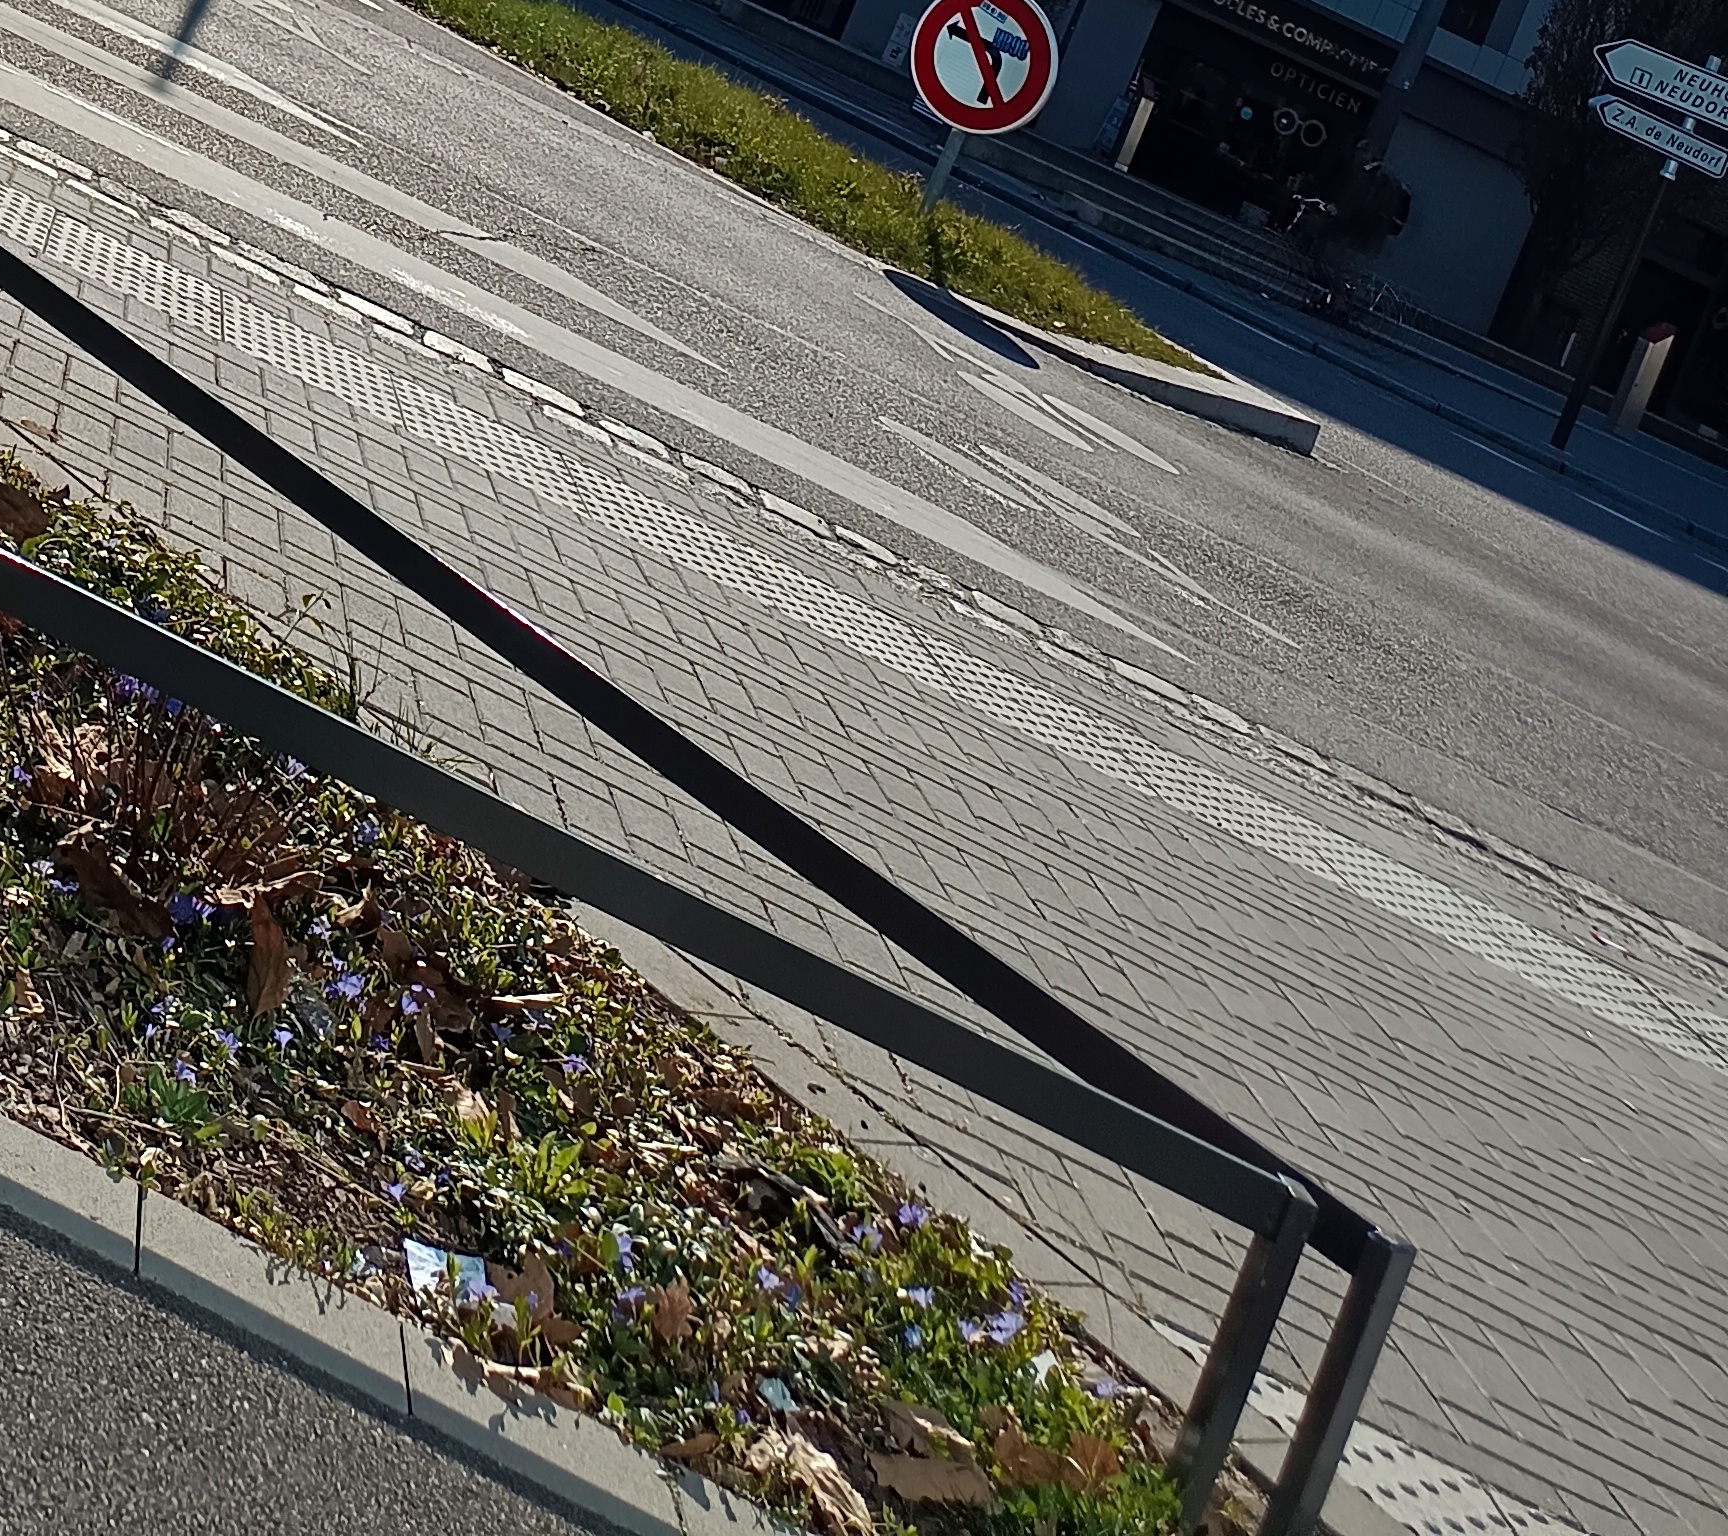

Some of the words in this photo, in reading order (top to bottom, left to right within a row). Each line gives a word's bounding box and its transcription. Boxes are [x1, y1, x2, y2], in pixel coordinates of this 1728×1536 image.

[1266, 15, 1280, 33] &
[1270, 61, 1362, 115] OPTICIEN
[1673, 68, 1728, 103] NEUH
[1612, 108, 1639, 131] Z.A.
[1645, 125, 1662, 141] de
[1665, 133, 1724, 168] Neudorf
